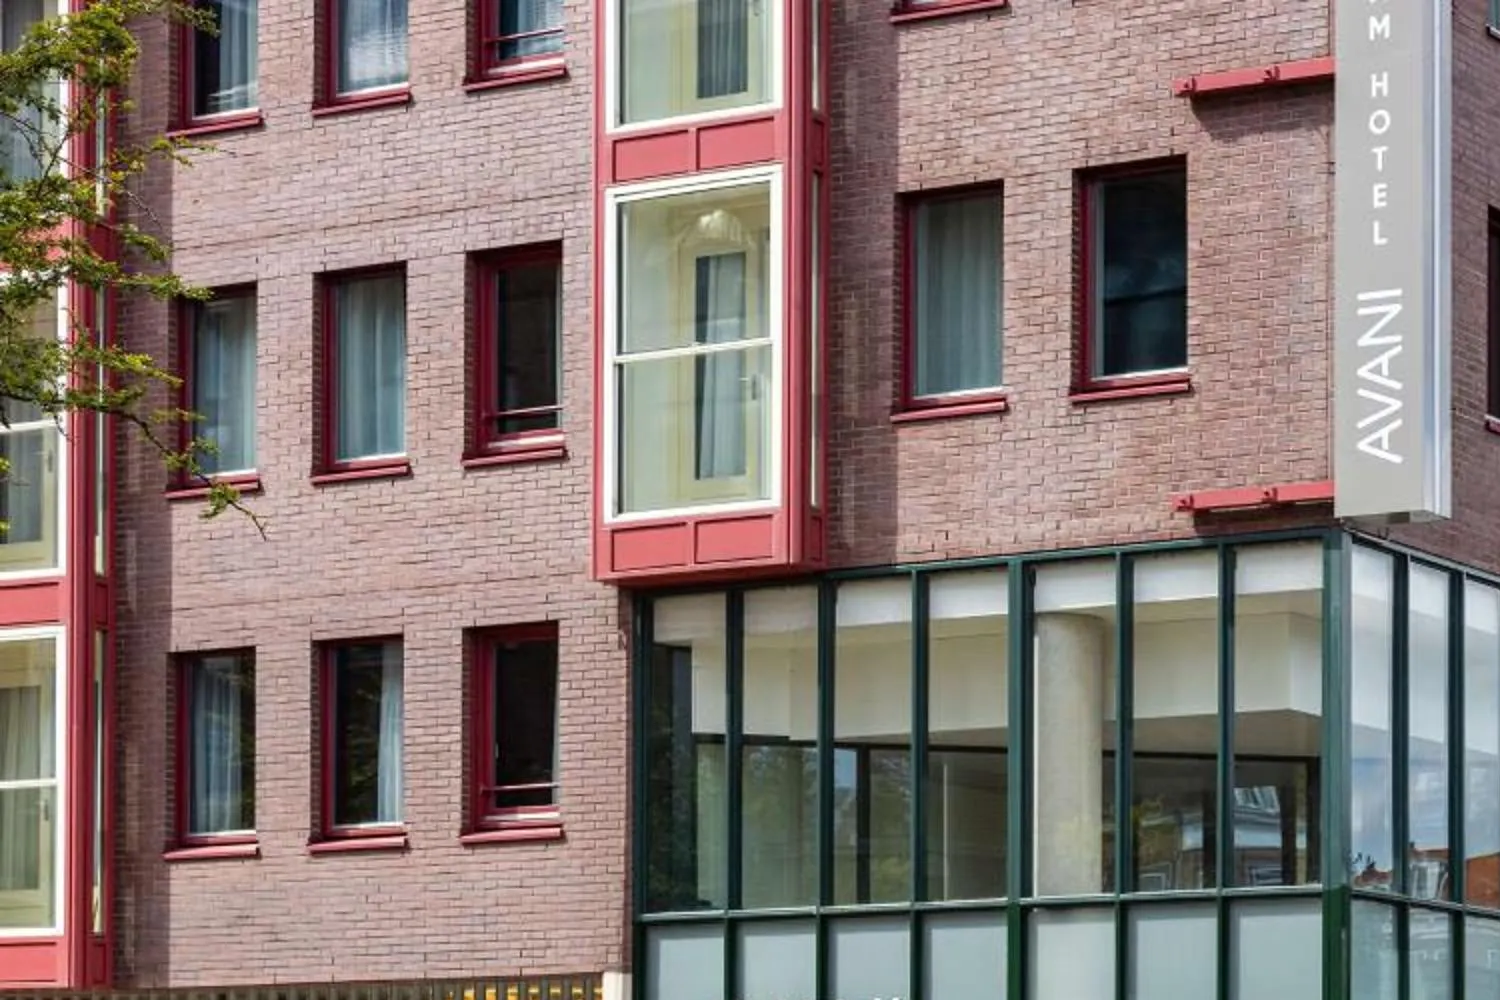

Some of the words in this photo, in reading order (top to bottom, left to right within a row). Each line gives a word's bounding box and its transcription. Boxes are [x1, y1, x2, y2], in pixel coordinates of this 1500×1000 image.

[1369, 0, 1391, 41] M
[1368, 71, 1392, 246] HOTEL
[1356, 287, 1404, 464] AVANI
